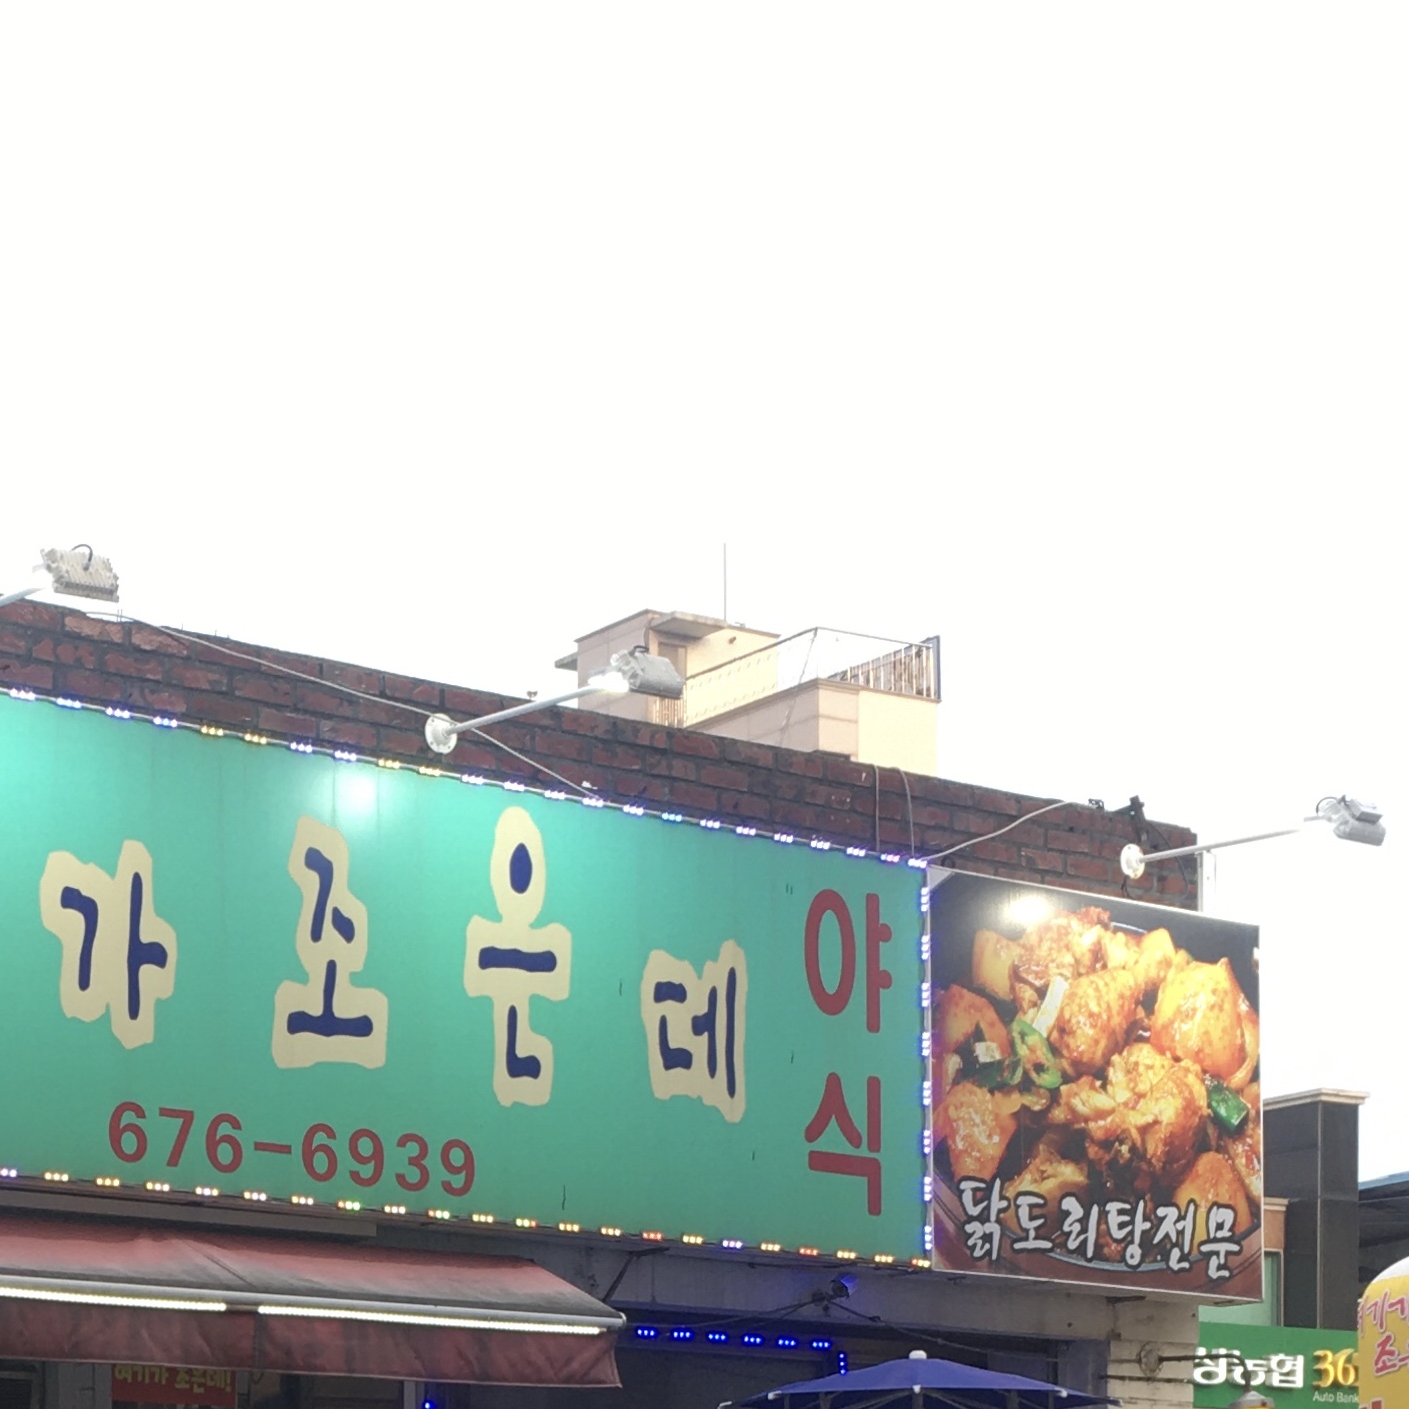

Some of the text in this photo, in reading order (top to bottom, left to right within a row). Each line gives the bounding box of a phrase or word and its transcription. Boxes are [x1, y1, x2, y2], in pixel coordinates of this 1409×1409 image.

[272, 807, 746, 1123] 조은데
[804, 889, 892, 1215] 야식
[108, 1101, 476, 1197] 676-6939
[1313, 1348, 1359, 1389] 36
[1313, 1391, 1335, 1403] Auto
